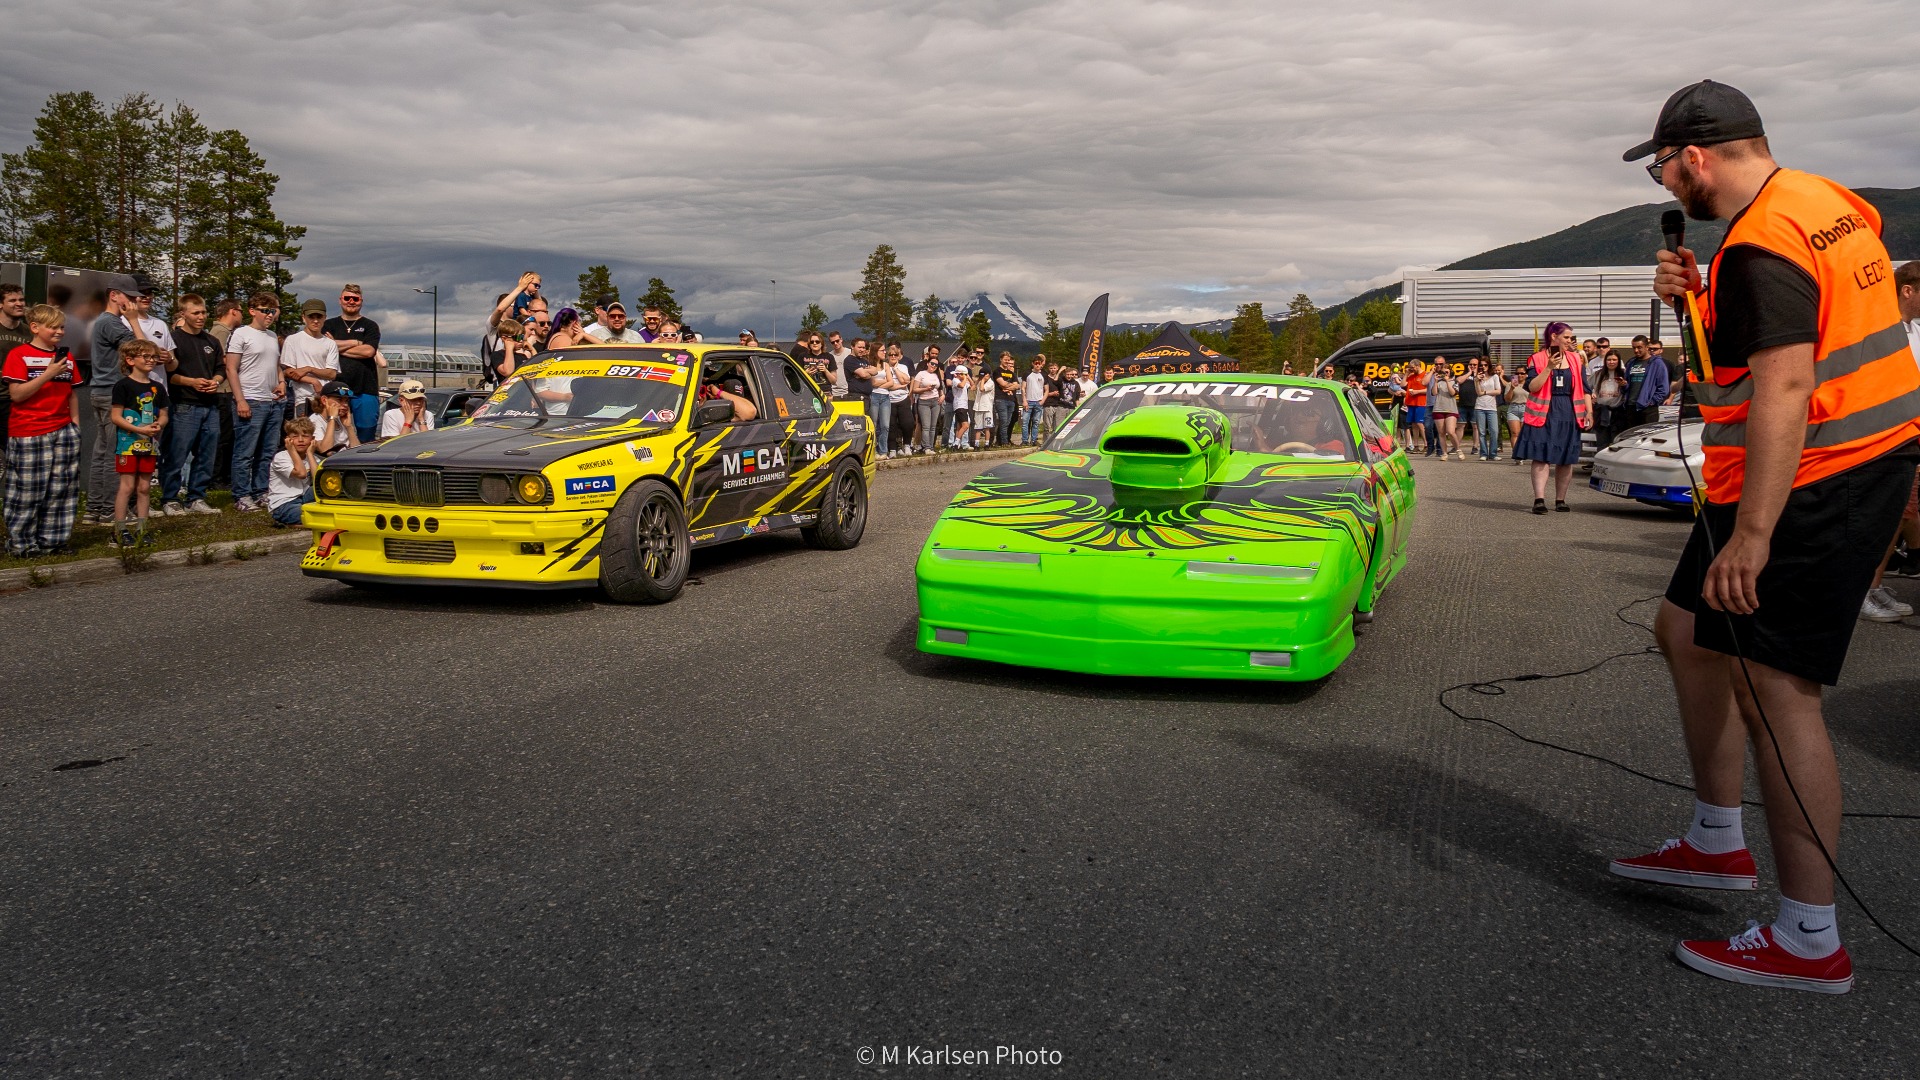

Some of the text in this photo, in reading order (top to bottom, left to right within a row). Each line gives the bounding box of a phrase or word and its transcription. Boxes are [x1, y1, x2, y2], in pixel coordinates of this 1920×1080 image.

[546, 369, 600, 377] SANDAKER
[607, 366, 641, 377] 897
[1112, 383, 1314, 402] PONTIAC
[779, 401, 787, 414] A
[577, 460, 607, 471] WORKWEAR
[723, 471, 786, 490] SERVICE LILLEHAMMER
